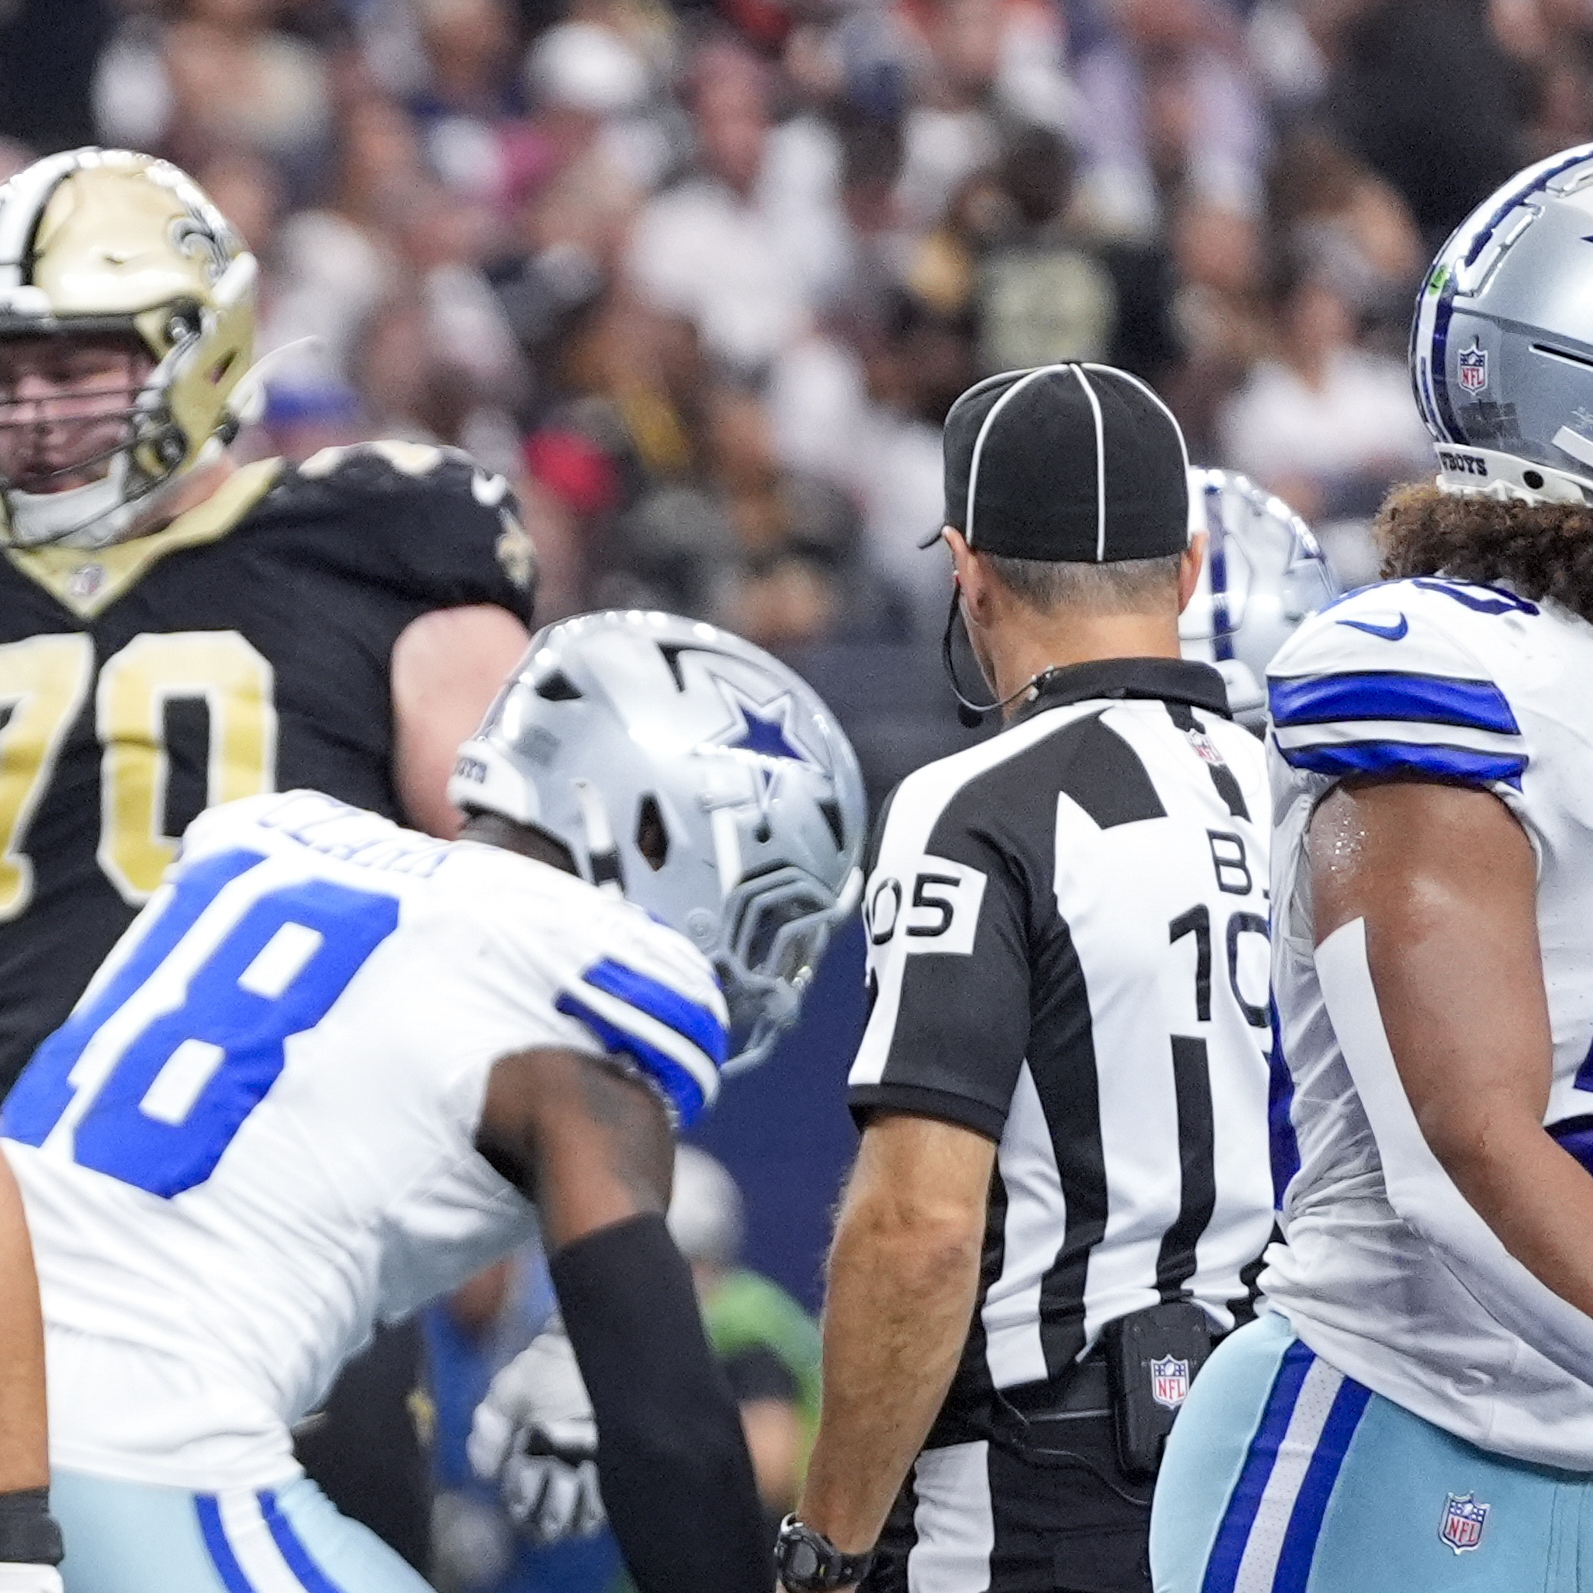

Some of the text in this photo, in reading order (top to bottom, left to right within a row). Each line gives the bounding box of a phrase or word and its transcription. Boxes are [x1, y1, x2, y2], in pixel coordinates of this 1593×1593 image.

[1460, 367, 1483, 386] NFL
[1206, 828, 1271, 899] B
[866, 872, 963, 946] 05
[1157, 1378, 1185, 1400] NFL
[1446, 1517, 1478, 1543] NFL
